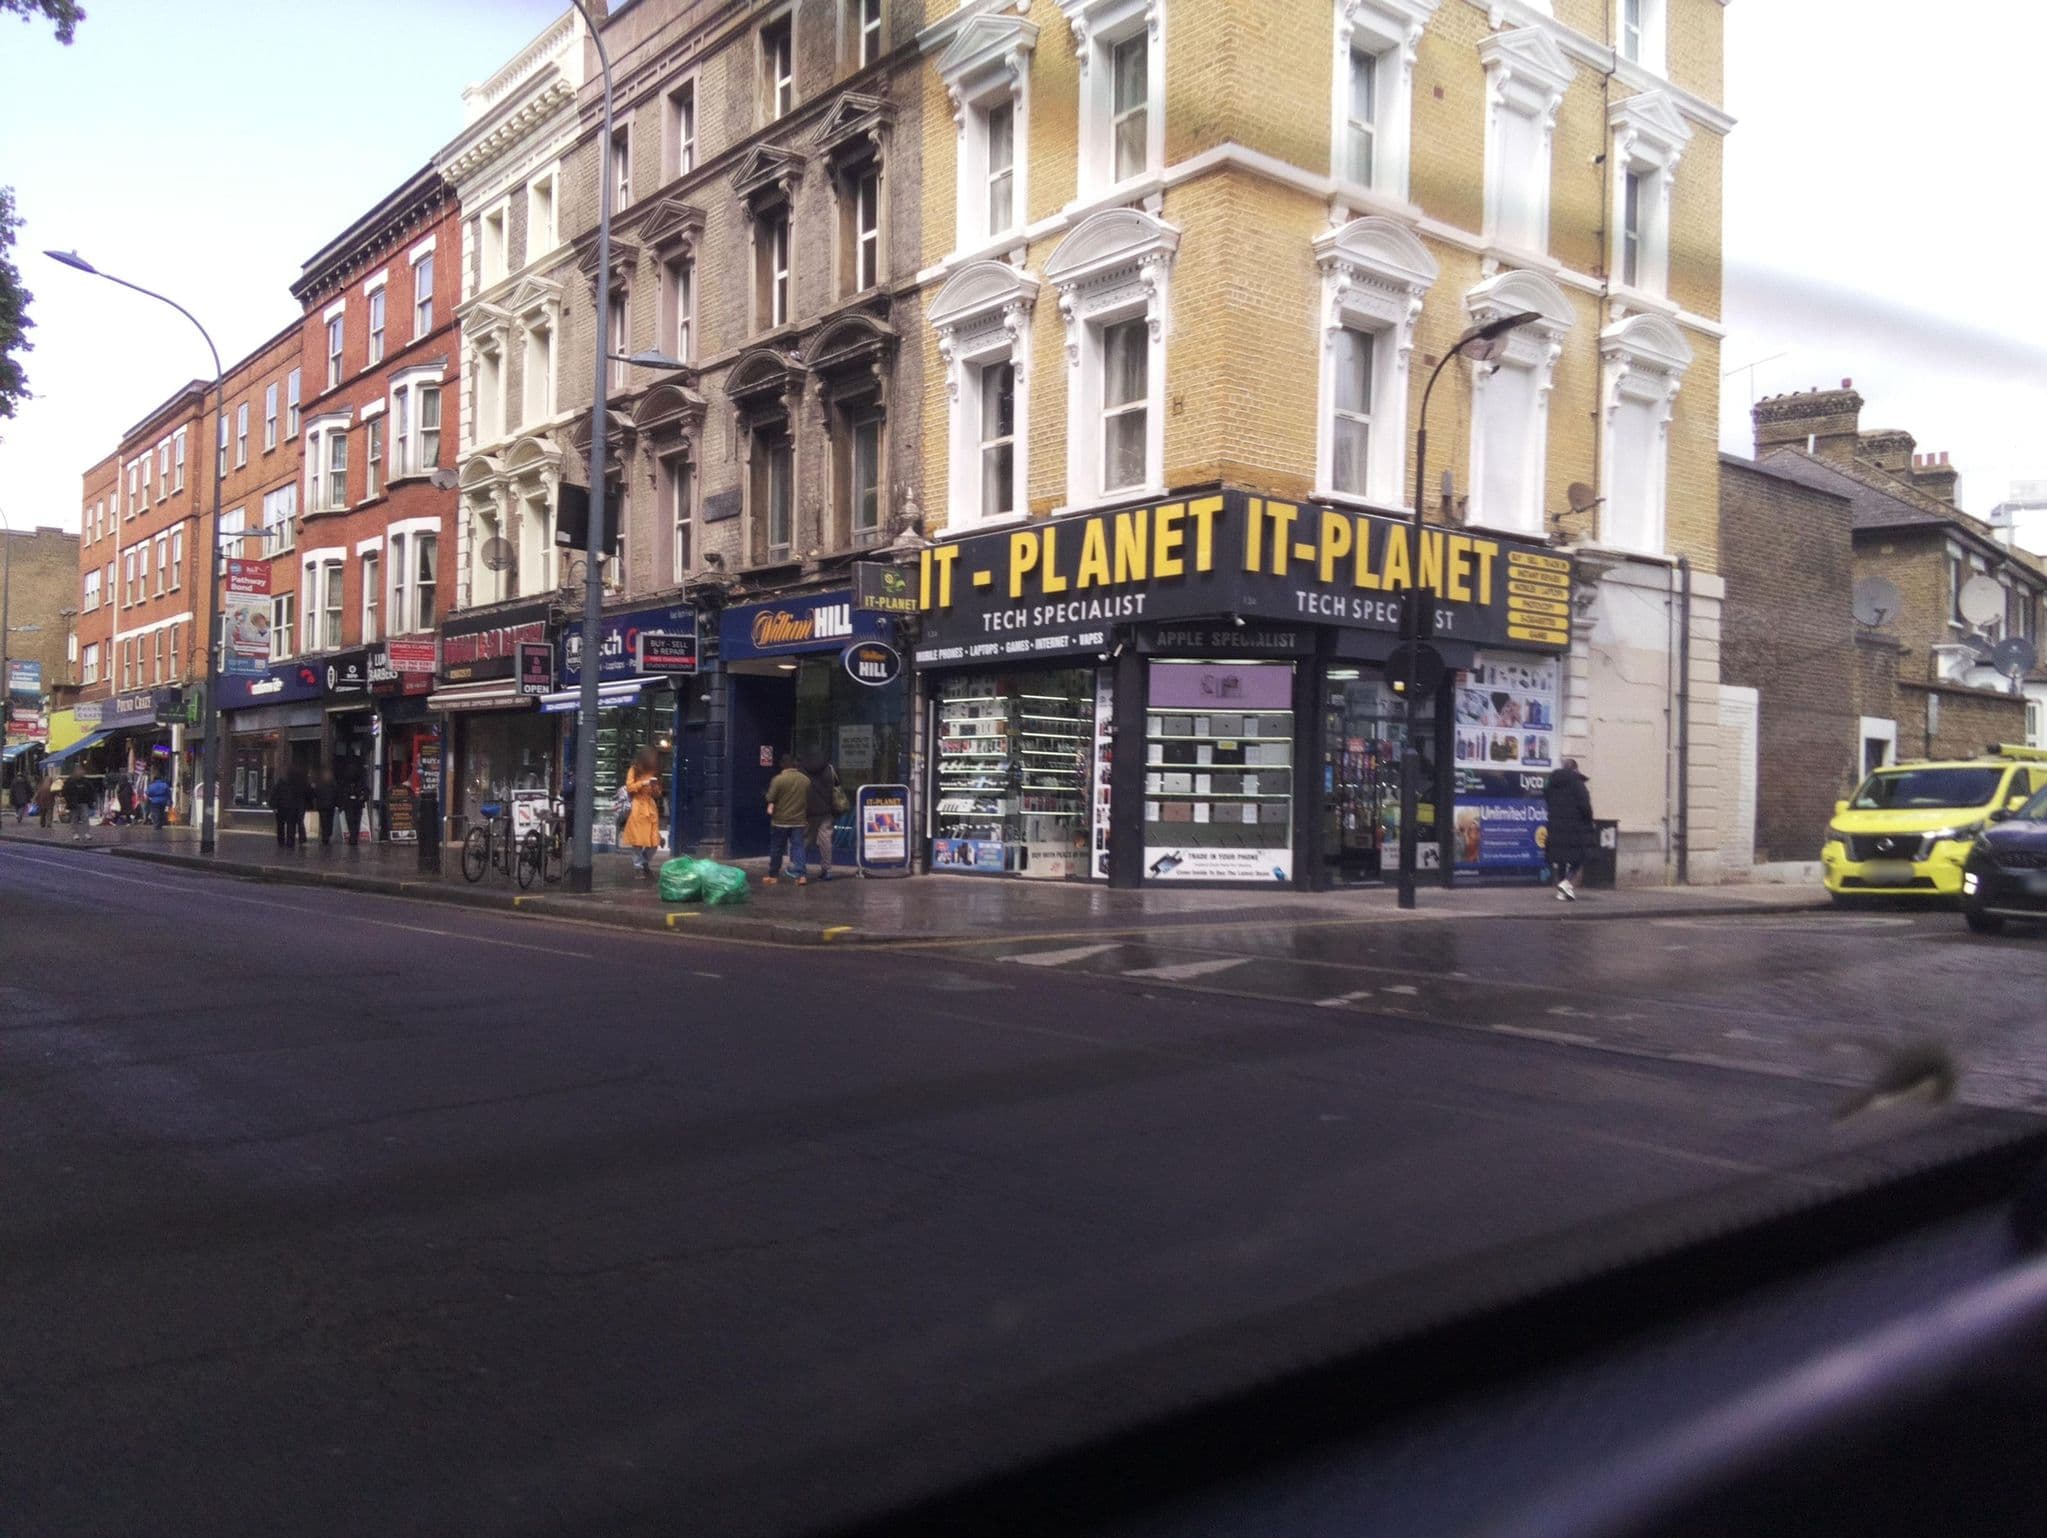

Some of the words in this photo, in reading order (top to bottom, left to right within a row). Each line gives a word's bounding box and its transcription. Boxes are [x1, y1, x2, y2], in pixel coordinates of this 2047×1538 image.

[920, 545, 959, 610] IT
[1010, 495, 1223, 598] PLANET
[1245, 497, 1498, 606] IT-PLANET
[231, 575, 266, 587] Pathway
[231, 583, 253, 592] Bond
[865, 595, 918, 611] IT-PLANET
[1296, 591, 1346, 617] TECH
[1352, 598, 1454, 630] SPECST
[983, 608, 1027, 632] TECH
[1034, 593, 1145, 626] SPECIALIST
[752, 609, 815, 646] William
[814, 604, 852, 638] HILL
[651, 640, 665, 648] BUY
[672, 640, 688, 649] SELL
[916, 650, 938, 662] MOBILE
[939, 646, 963, 659] PHONES
[970, 644, 998, 657] LAPTOPS
[1006, 640, 1029, 653] GAMES
[1035, 635, 1069, 650] INTERNET
[1079, 632, 1104, 645] VAPES
[1157, 632, 1203, 647] APPLE
[859, 662, 888, 677] HILL
[523, 684, 550, 693] OPEN
[1520, 773, 1544, 790] Lyca
[1480, 805, 1526, 821] Unlimited
